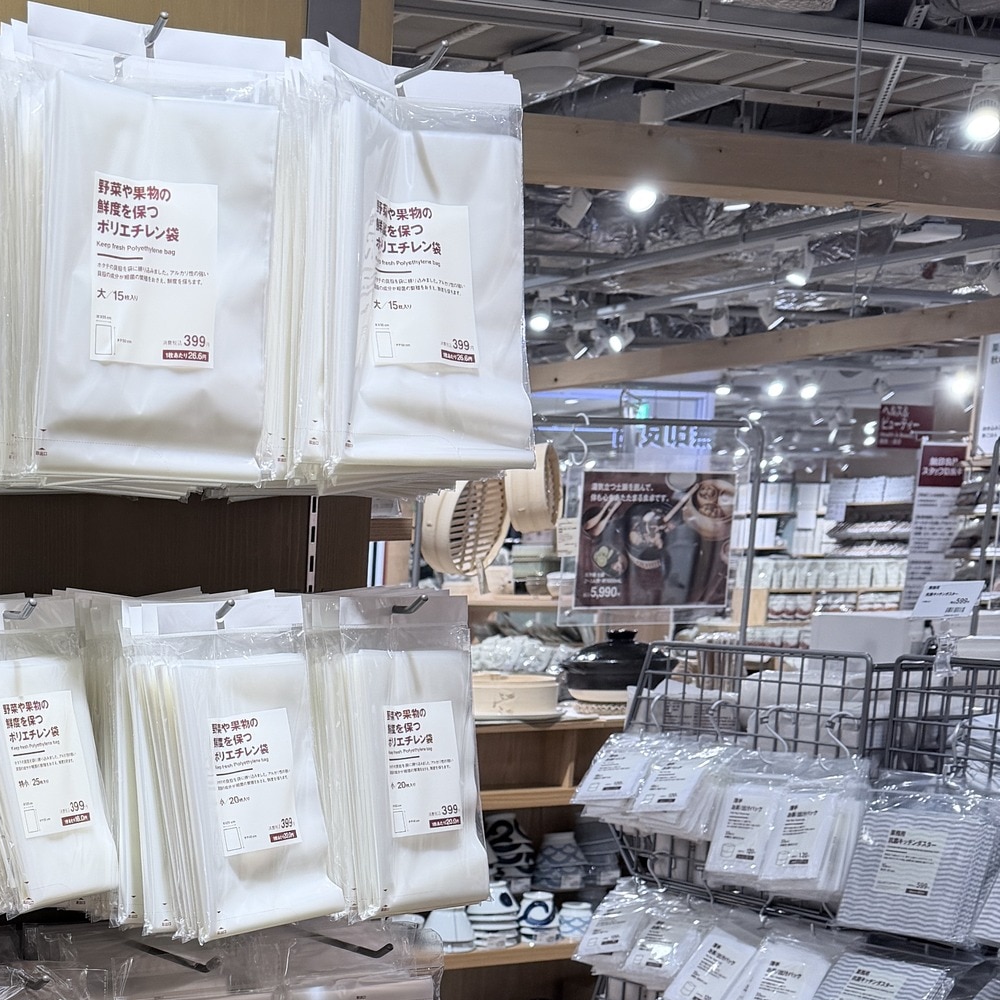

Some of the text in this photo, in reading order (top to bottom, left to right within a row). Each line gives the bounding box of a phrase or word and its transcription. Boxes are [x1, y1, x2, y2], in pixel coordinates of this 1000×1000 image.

[98, 179, 171, 201] 野菜や果物の
[97, 199, 158, 219] 鮮度を保つ
[98, 219, 179, 242] ポリエチレン袋
[112, 243, 125, 251] fresh
[127, 244, 162, 255] Polyethylene
[3, 700, 49, 714] 野菜や果物の
[6, 715, 43, 728] 鮮度を保つ
[9, 726, 59, 742] ポリエチレン袋
